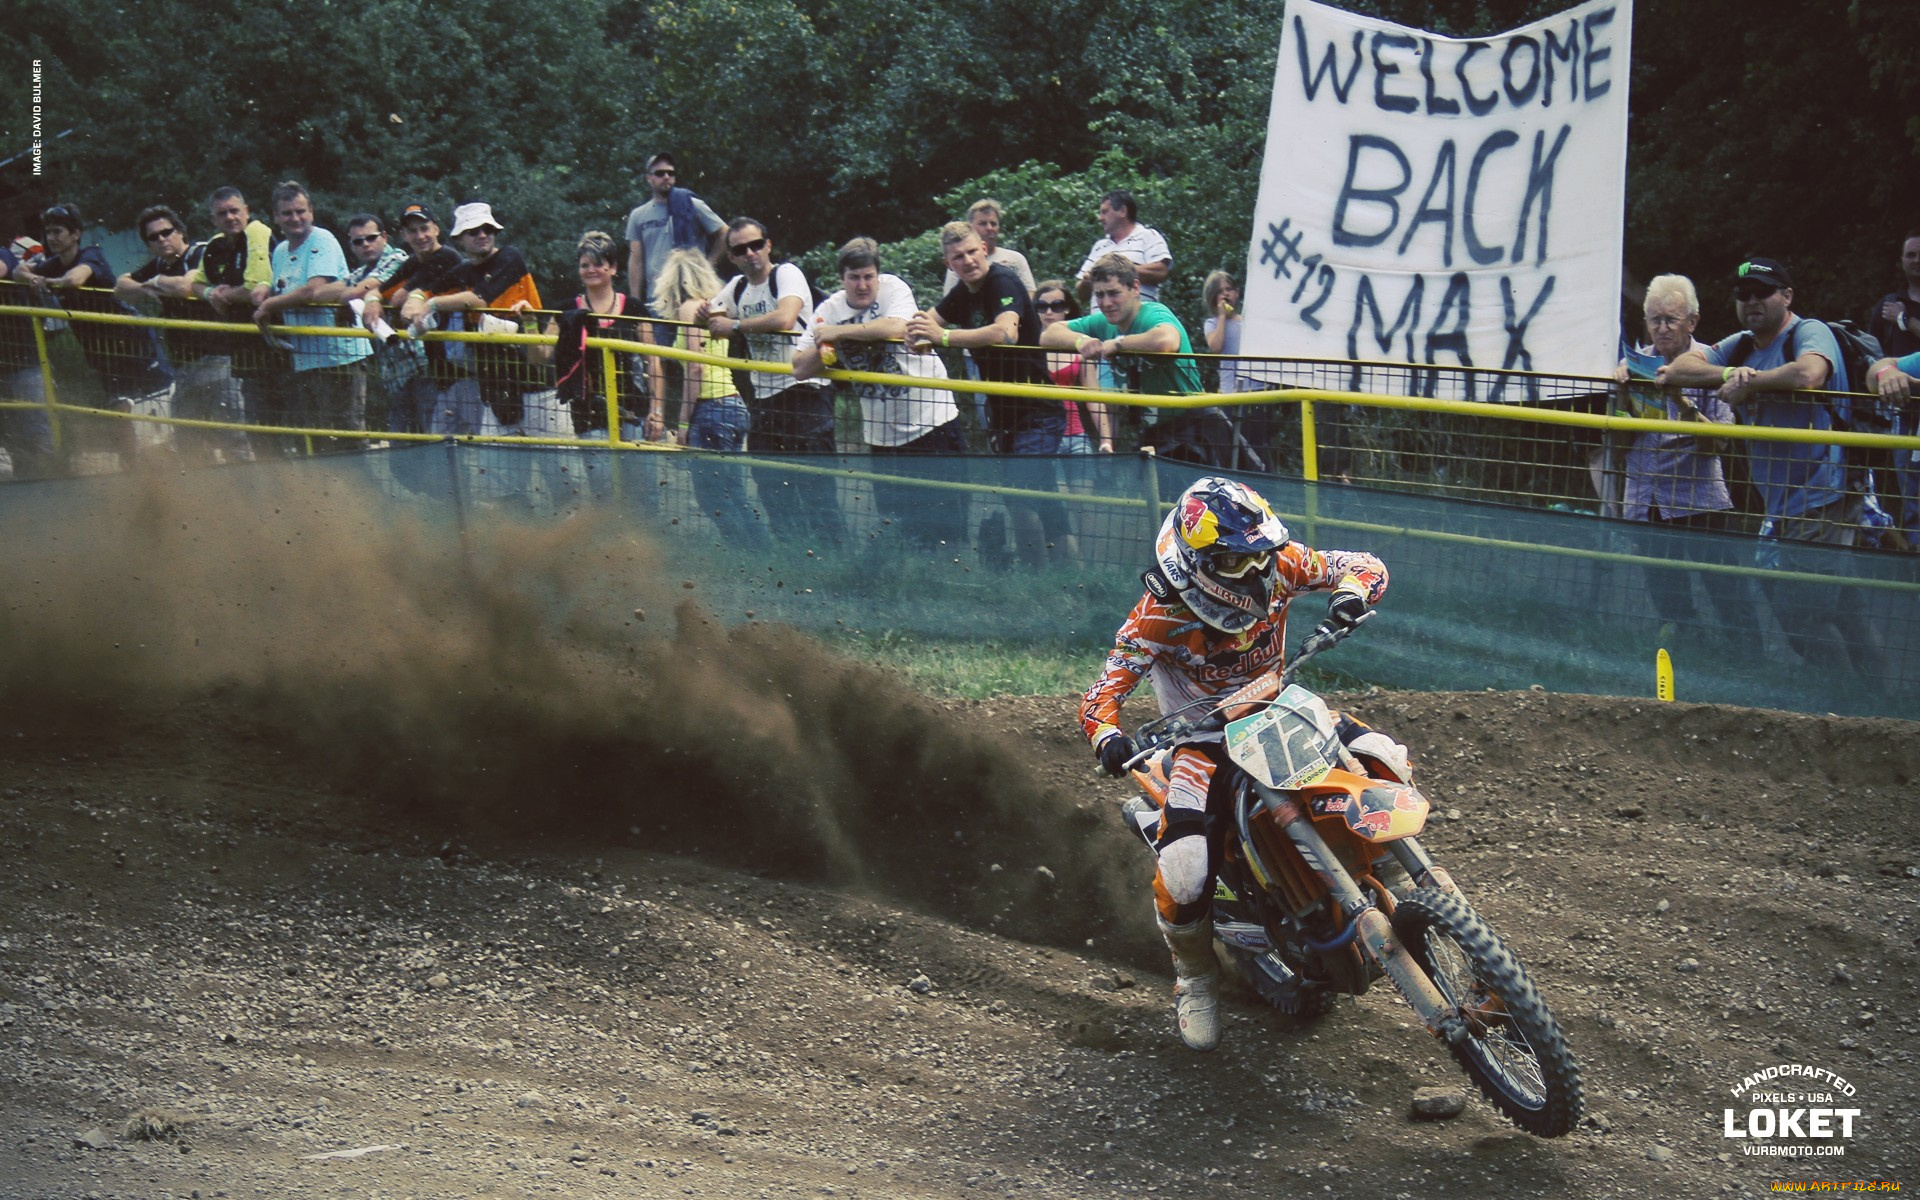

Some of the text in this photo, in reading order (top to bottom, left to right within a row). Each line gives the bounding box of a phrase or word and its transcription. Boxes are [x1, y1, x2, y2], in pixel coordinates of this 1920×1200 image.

[1294, 7, 1616, 117] WELCOME
[1331, 124, 1572, 268] BACK
[1260, 217, 1336, 331] #12
[1346, 272, 1556, 401] MAX
[1163, 556, 1182, 582] VANS
[1257, 705, 1323, 787] 12
